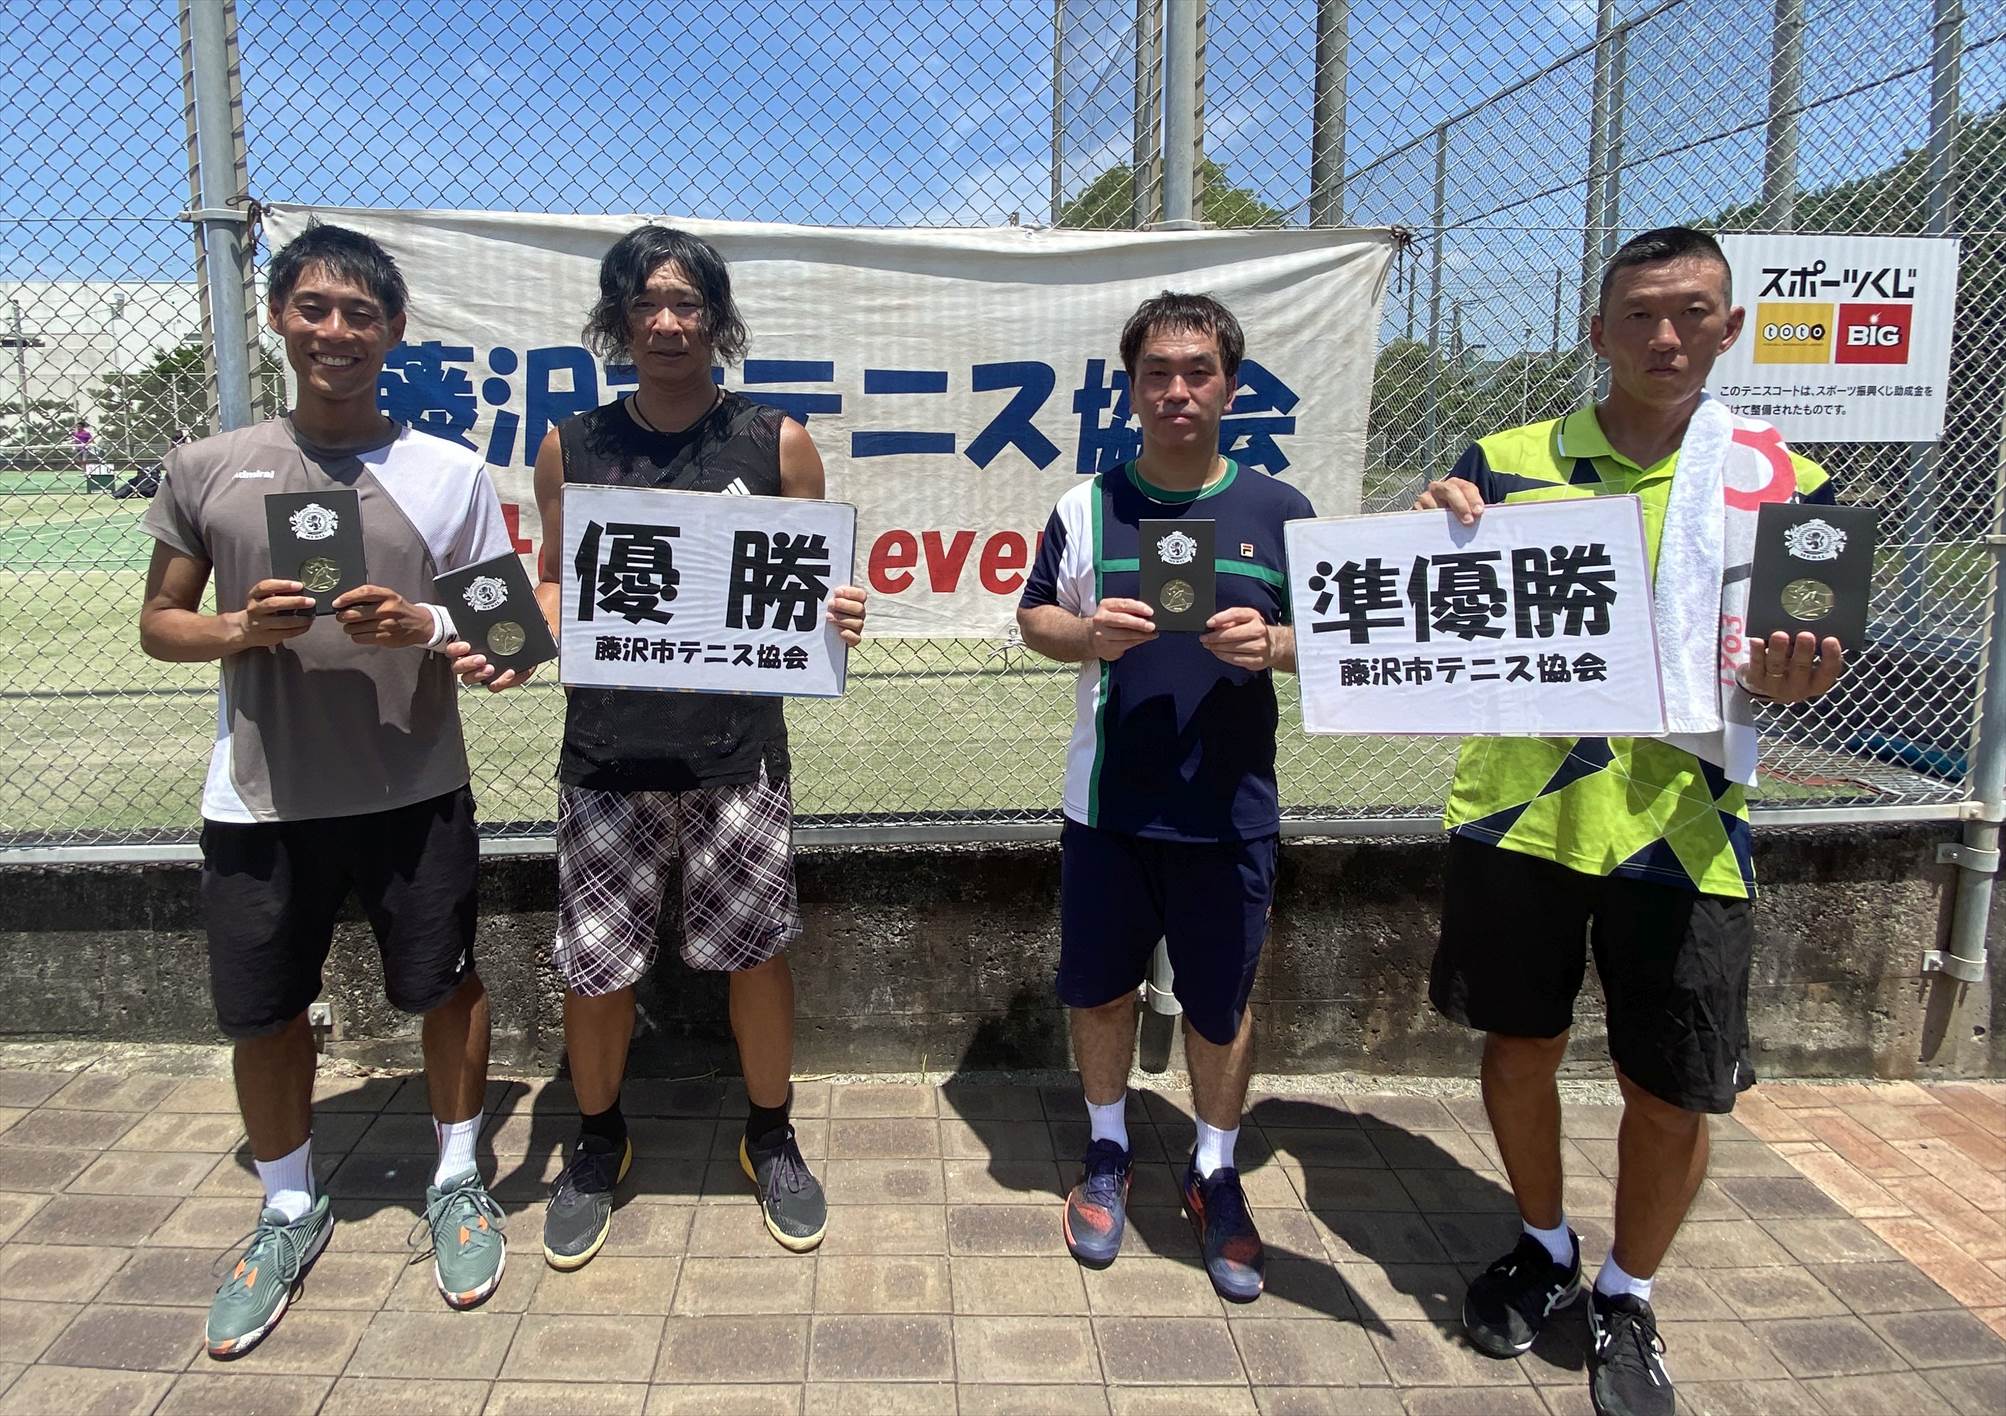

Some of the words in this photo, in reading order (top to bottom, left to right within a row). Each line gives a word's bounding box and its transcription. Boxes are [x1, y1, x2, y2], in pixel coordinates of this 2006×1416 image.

[1758, 259, 1918, 299] スポーツくじ
[1764, 323, 1825, 341] toto
[1846, 324, 1902, 347] BIG
[1720, 385, 1934, 398] このテニスコートは、スポーツ振興くじ助成金を
[1725, 404, 1848, 416] けて整備されたものです。
[574, 519, 831, 632] 優勝
[868, 529, 1045, 596] eve
[1308, 543, 1618, 644] 準優勝
[594, 635, 809, 670] 藤沢市テニス協会
[1339, 652, 1608, 687] 藤沢市テニス協会
